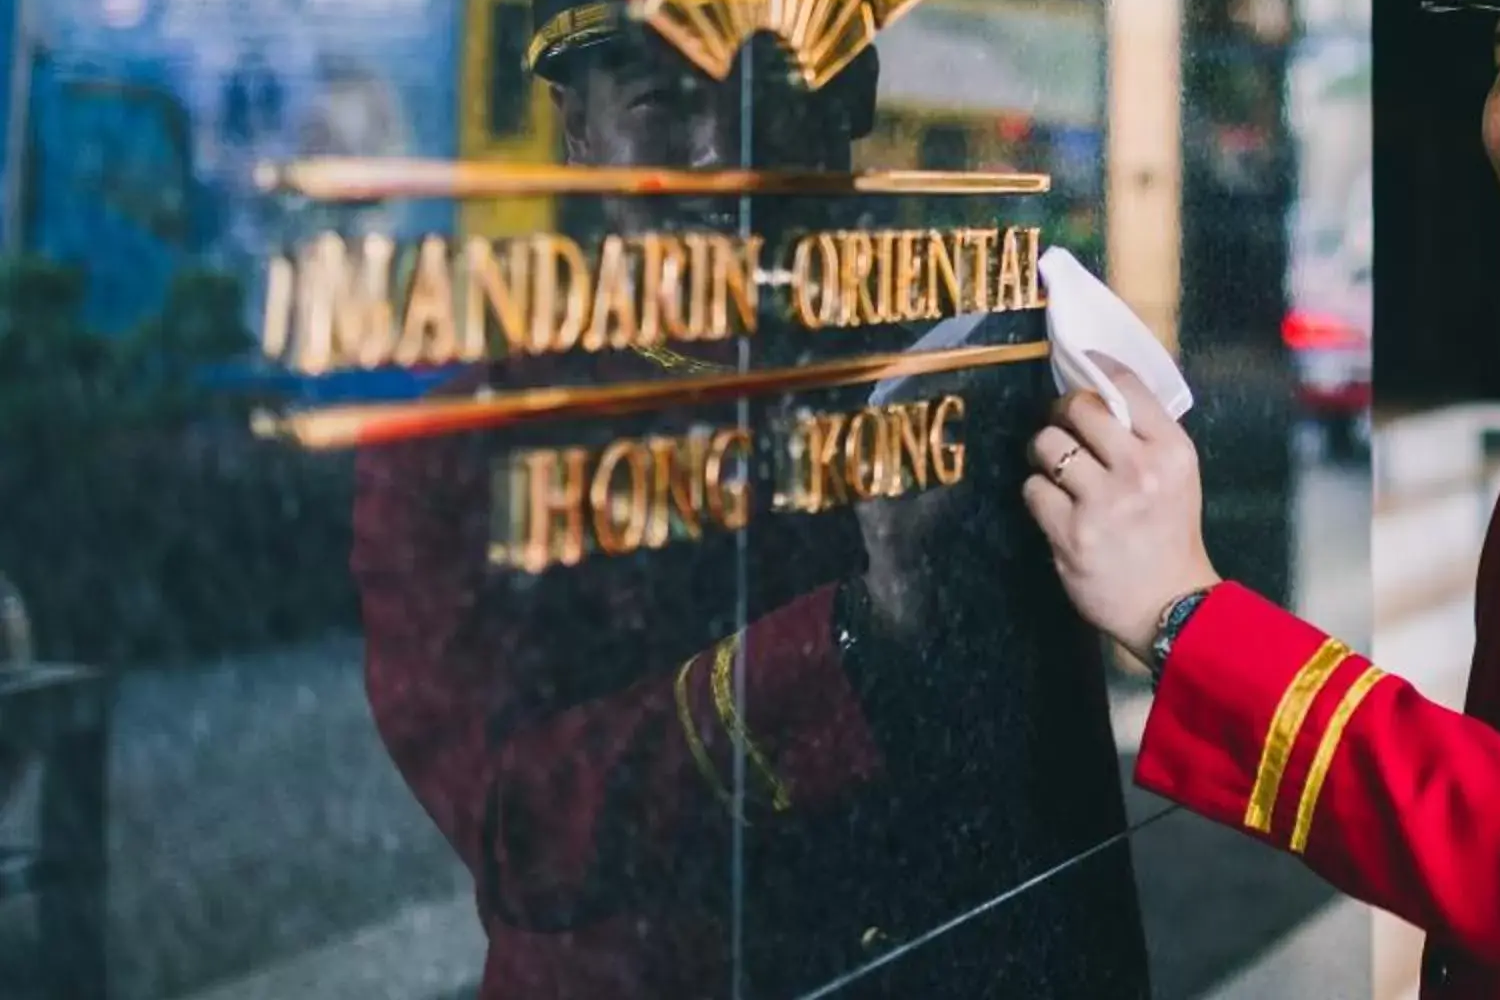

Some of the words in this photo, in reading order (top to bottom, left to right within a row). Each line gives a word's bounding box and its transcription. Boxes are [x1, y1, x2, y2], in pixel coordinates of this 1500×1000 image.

[288, 229, 762, 376] MANDARIN
[793, 226, 1047, 329] ORIENTAL
[516, 428, 752, 574] HONG
[794, 394, 967, 514] KONG
